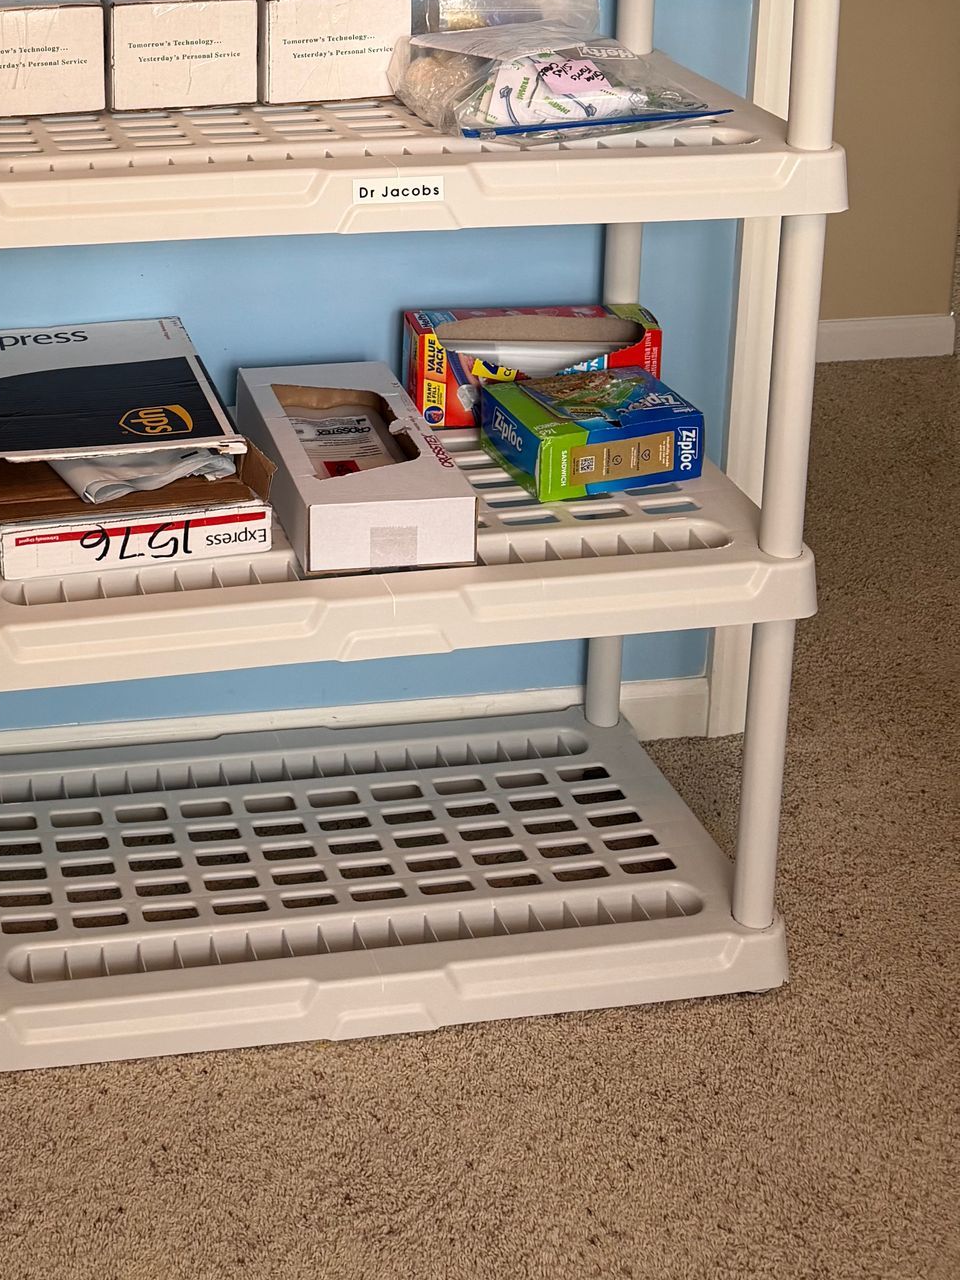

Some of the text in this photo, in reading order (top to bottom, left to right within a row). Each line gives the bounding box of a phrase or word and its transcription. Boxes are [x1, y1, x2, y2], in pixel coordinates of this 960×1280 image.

[19, 44, 68, 54] Technology...
[128, 37, 222, 49] Tomorrow's Technology...
[282, 33, 375, 46] Tomorrow's Technology...
[138, 50, 241, 64] Yesterday's Personal Service
[292, 46, 394, 60] Yesterday's Personal Service
[583, 47, 634, 58] Hefty
[28, 59, 60, 69] Personal
[61, 57, 88, 67] Service
[359, 184, 440, 199] Dr Jacobs
[427, 339, 435, 371] VALUE
[436, 348, 444, 374] PACK
[130, 408, 173, 434] ups
[494, 411, 523, 452] Ziploc
[423, 434, 454, 468] CROSSTEX
[676, 429, 696, 471] Ziploc
[560, 450, 568, 487] SANDWICH
[79, 520, 192, 561] 1576
[205, 528, 267, 547] Express
